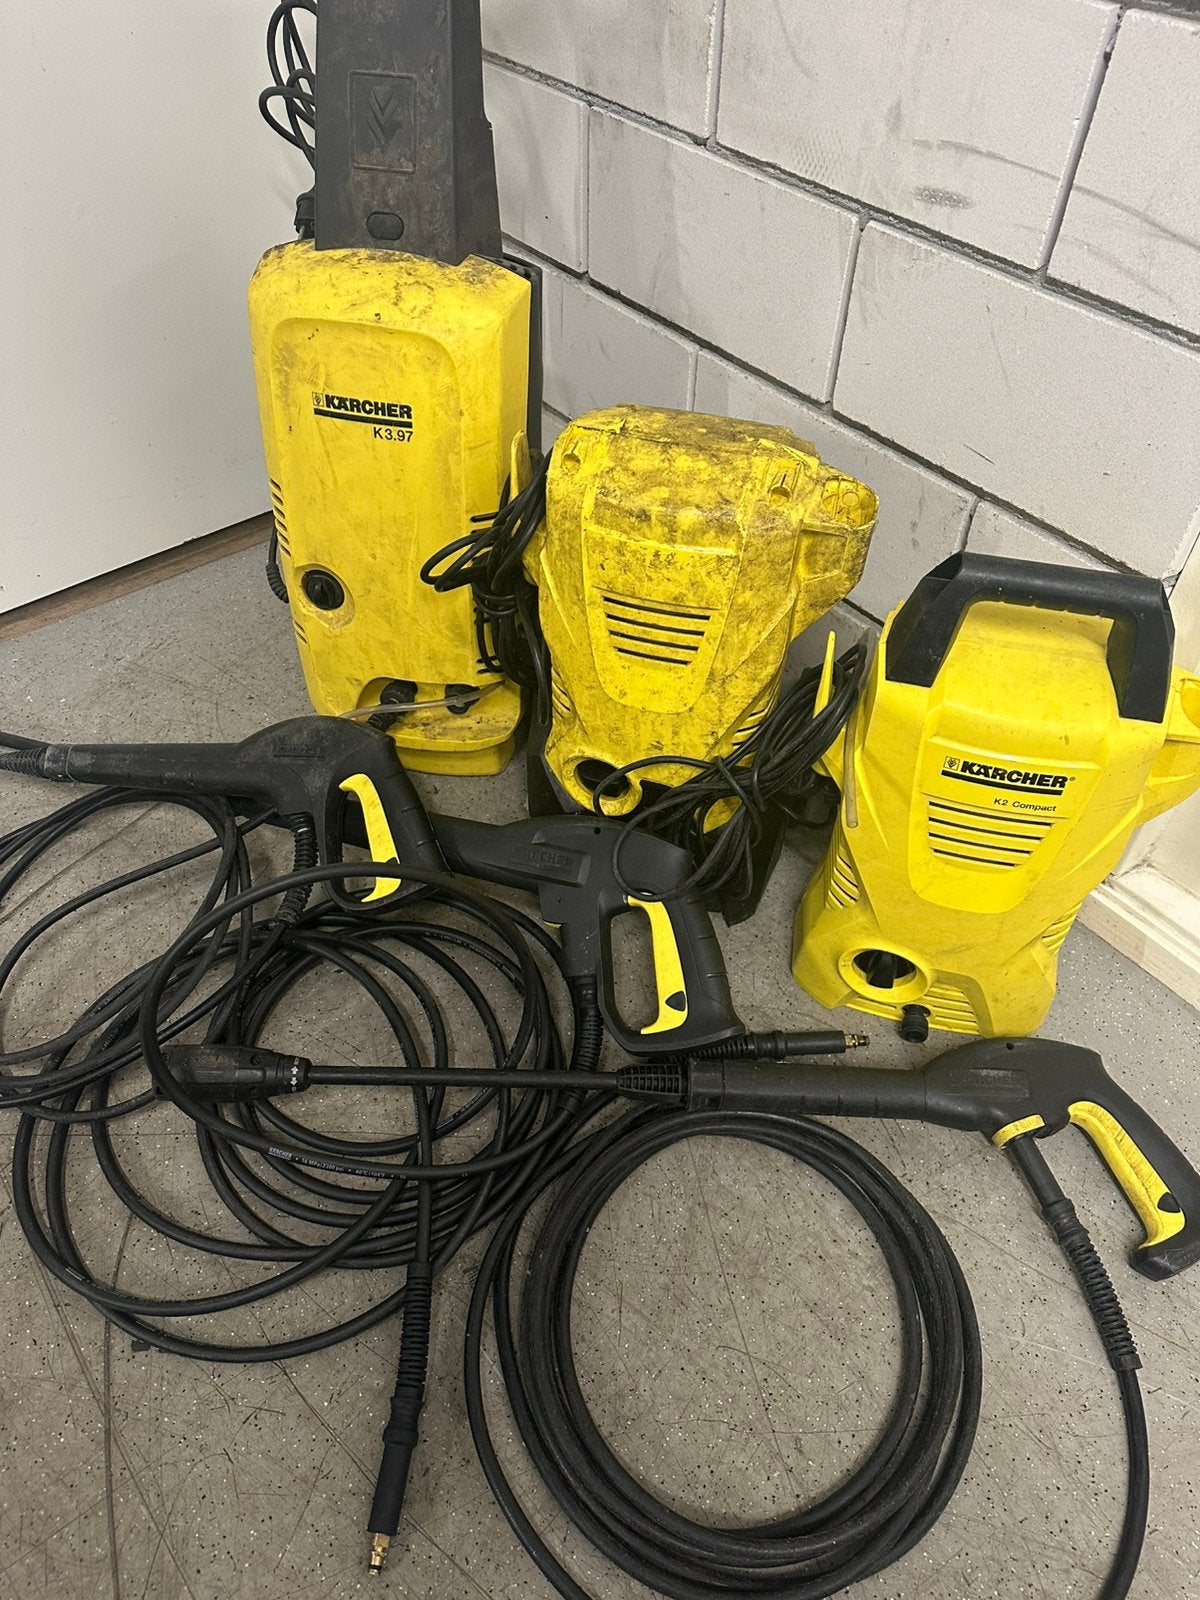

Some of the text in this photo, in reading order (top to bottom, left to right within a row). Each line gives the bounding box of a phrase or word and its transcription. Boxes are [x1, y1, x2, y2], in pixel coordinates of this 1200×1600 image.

[324, 394, 413, 419] KÄRCHER
[993, 798, 1057, 812] K2 Compact
